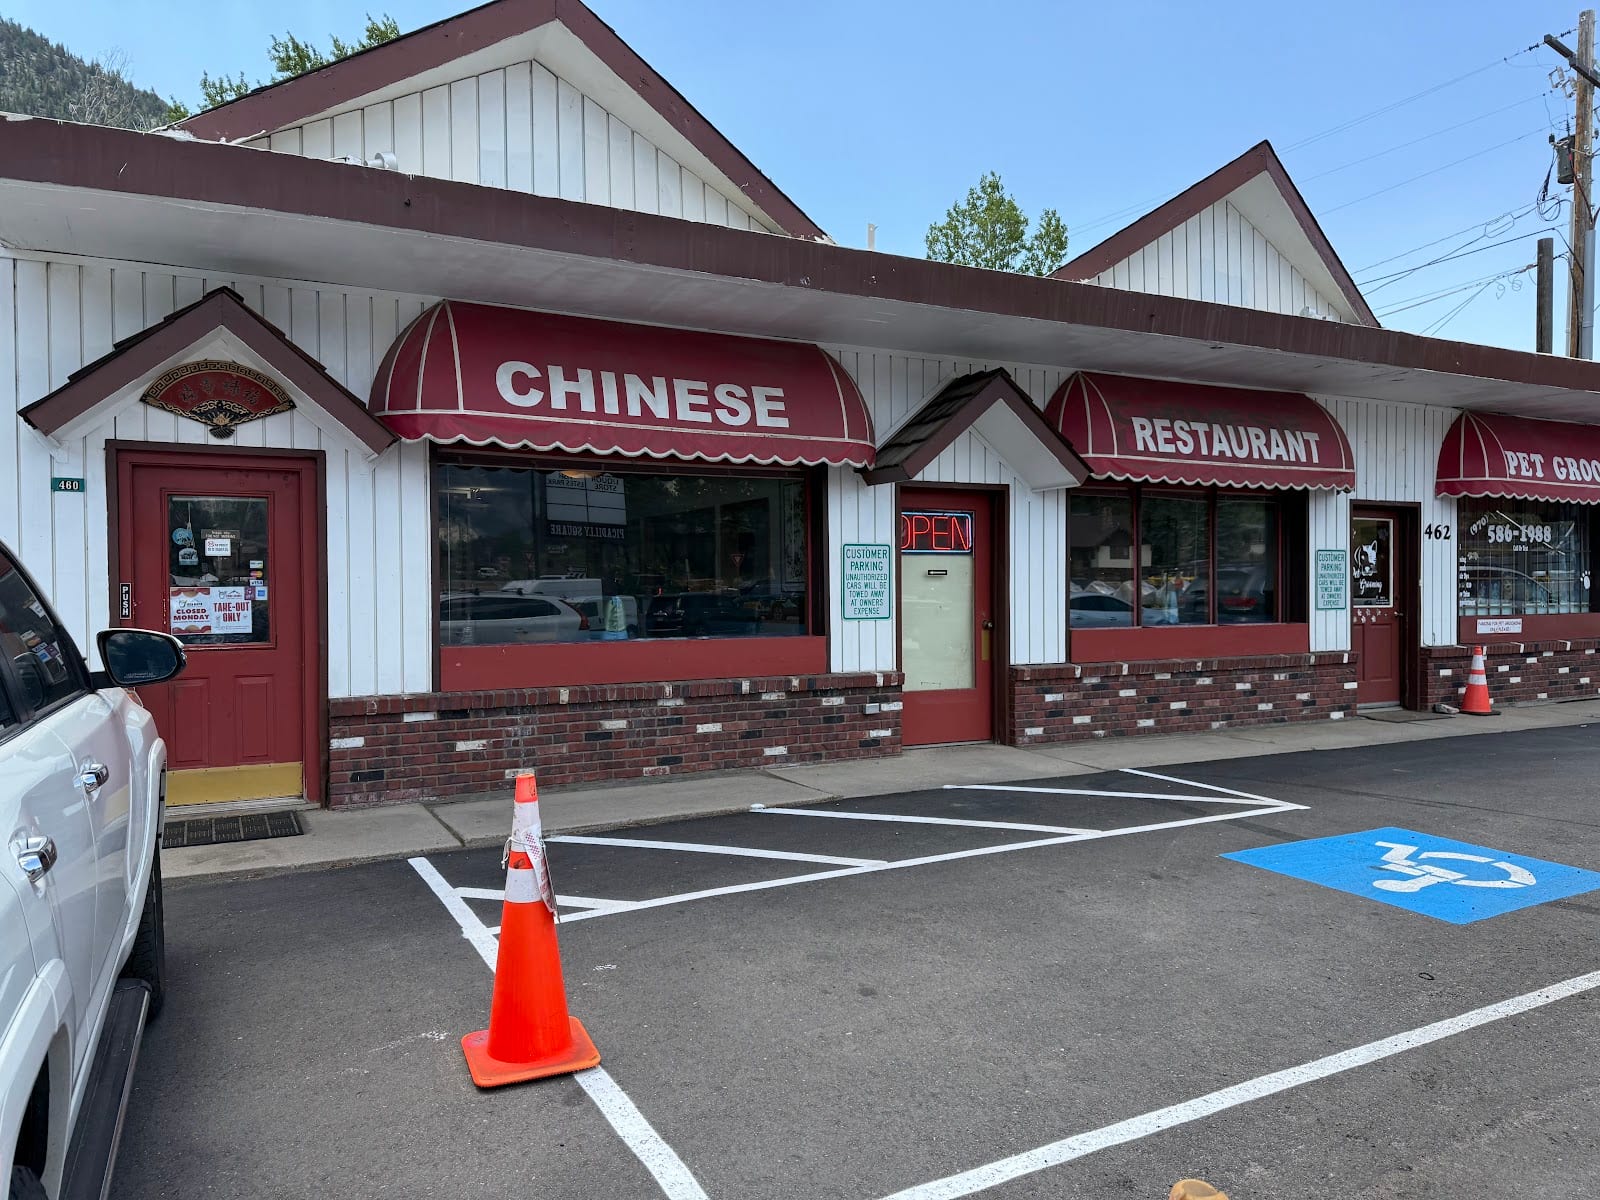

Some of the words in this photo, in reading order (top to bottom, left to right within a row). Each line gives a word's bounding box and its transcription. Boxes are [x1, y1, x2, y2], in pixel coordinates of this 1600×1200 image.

[495, 360, 790, 428] CHINESE
[1131, 416, 1320, 463] RESTAURANT
[1504, 450, 1544, 478] PET
[58, 480, 79, 491] 460
[1469, 514, 1490, 536] (970)
[1423, 523, 1451, 540] 462
[1487, 524, 1552, 544] 586-1988
[845, 549, 888, 559] CUSTOMER
[850, 561, 883, 571] PARKING
[845, 573, 888, 581] UNAUTHORIZED
[849, 590, 868, 598] TOWED
[871, 590, 884, 598] AWAY
[121, 585, 129, 617] PUSH
[213, 601, 250, 612] TAKE-OUT
[853, 607, 880, 615] EXPENSE
[222, 612, 241, 622] ONLY
